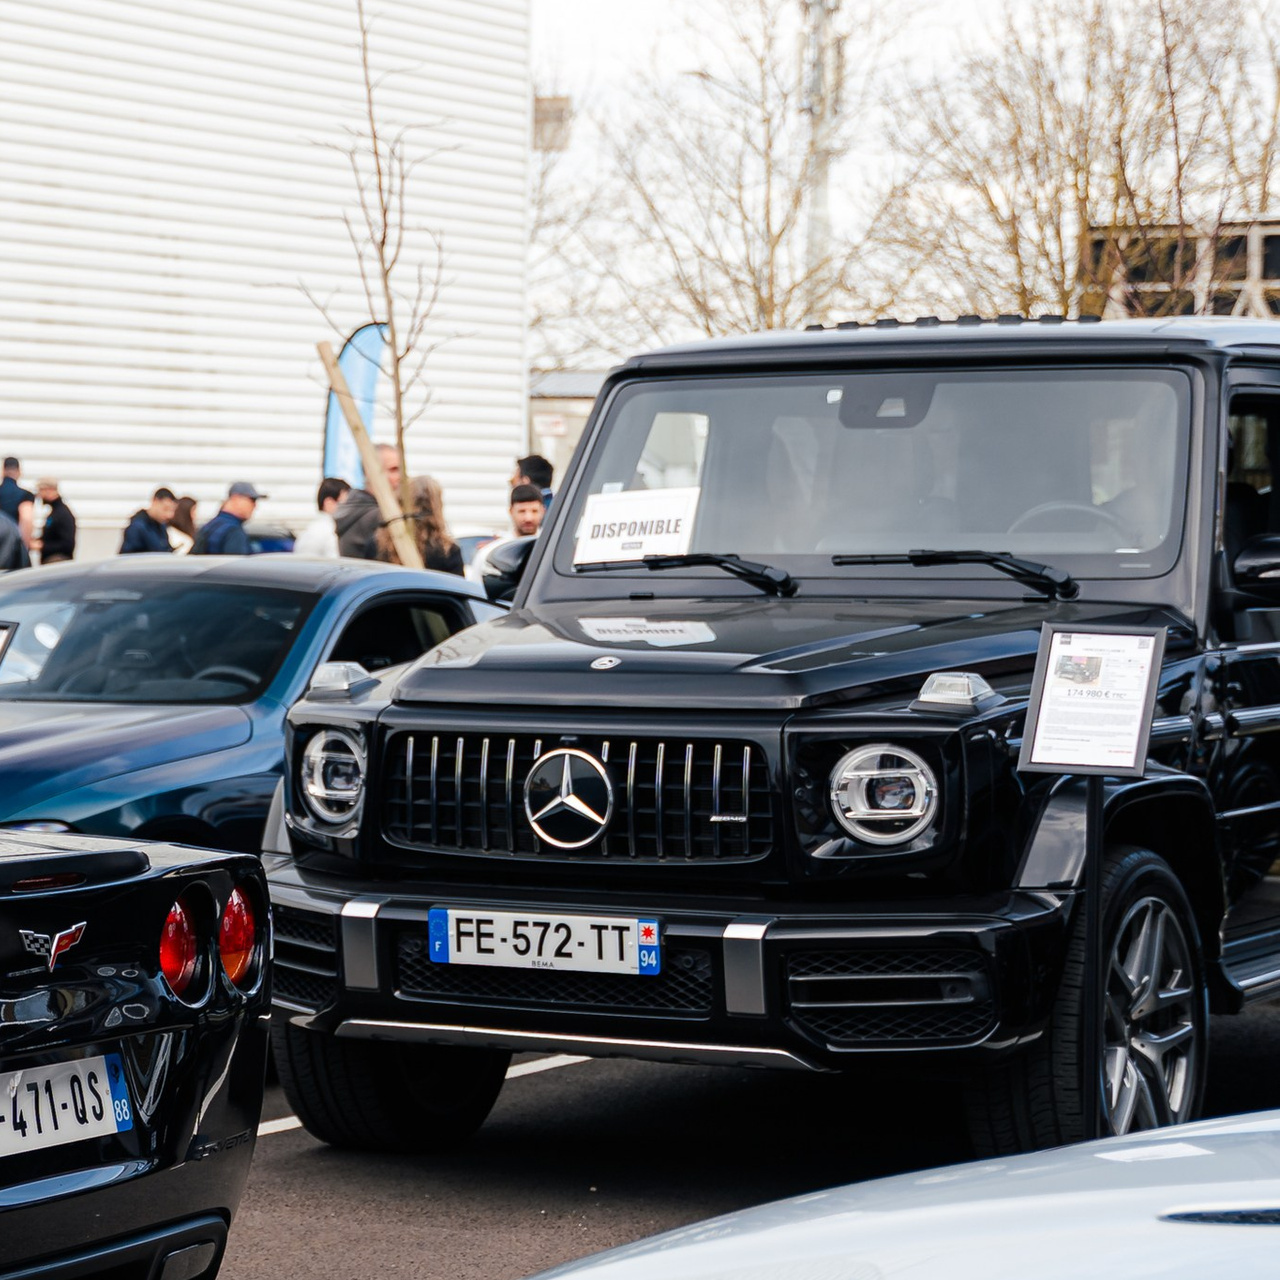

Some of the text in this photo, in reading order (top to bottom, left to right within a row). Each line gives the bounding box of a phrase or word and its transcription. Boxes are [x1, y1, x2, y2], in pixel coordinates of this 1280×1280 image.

[590, 518, 682, 539] DISPONIBLE
[1067, 688, 1083, 697] 174
[1085, 689, 1103, 698] 980
[434, 917, 657, 967] F FE-572-TT 94
[531, 960, 555, 969] BEMA
[114, 1098, 130, 1122] 88
